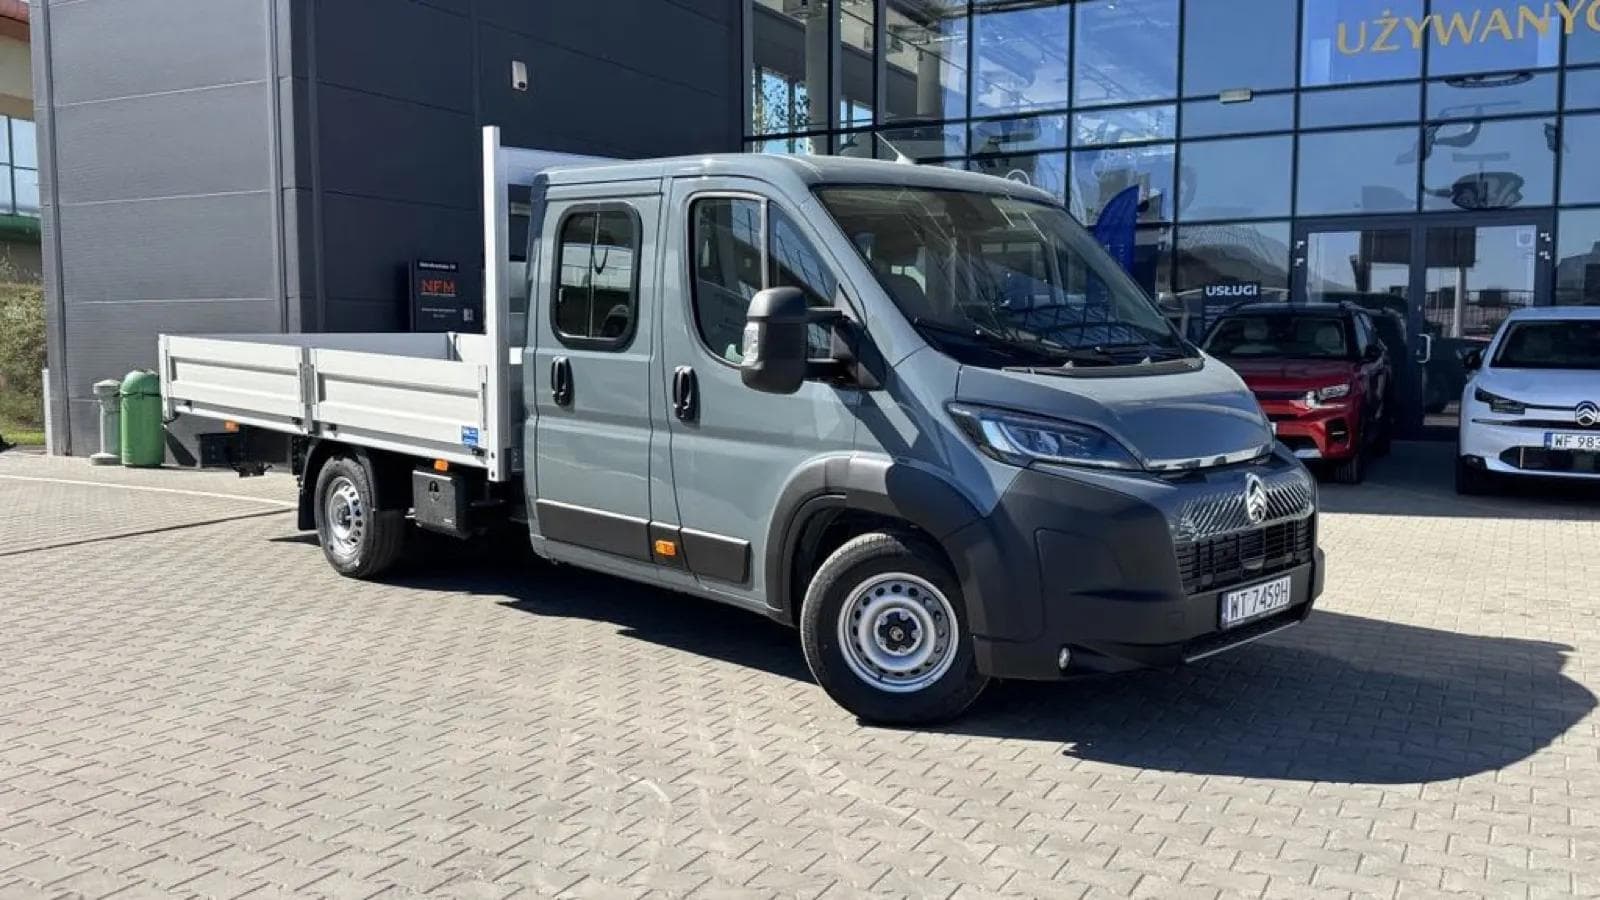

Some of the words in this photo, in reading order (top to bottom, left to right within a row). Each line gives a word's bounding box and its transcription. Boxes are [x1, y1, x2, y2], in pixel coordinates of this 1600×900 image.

[423, 279, 455, 294] NFM
[1205, 285, 1257, 296] USŁUGI
[1554, 434, 1572, 447] WF
[1230, 591, 1247, 618] WT
[1253, 580, 1288, 613] 7459H
